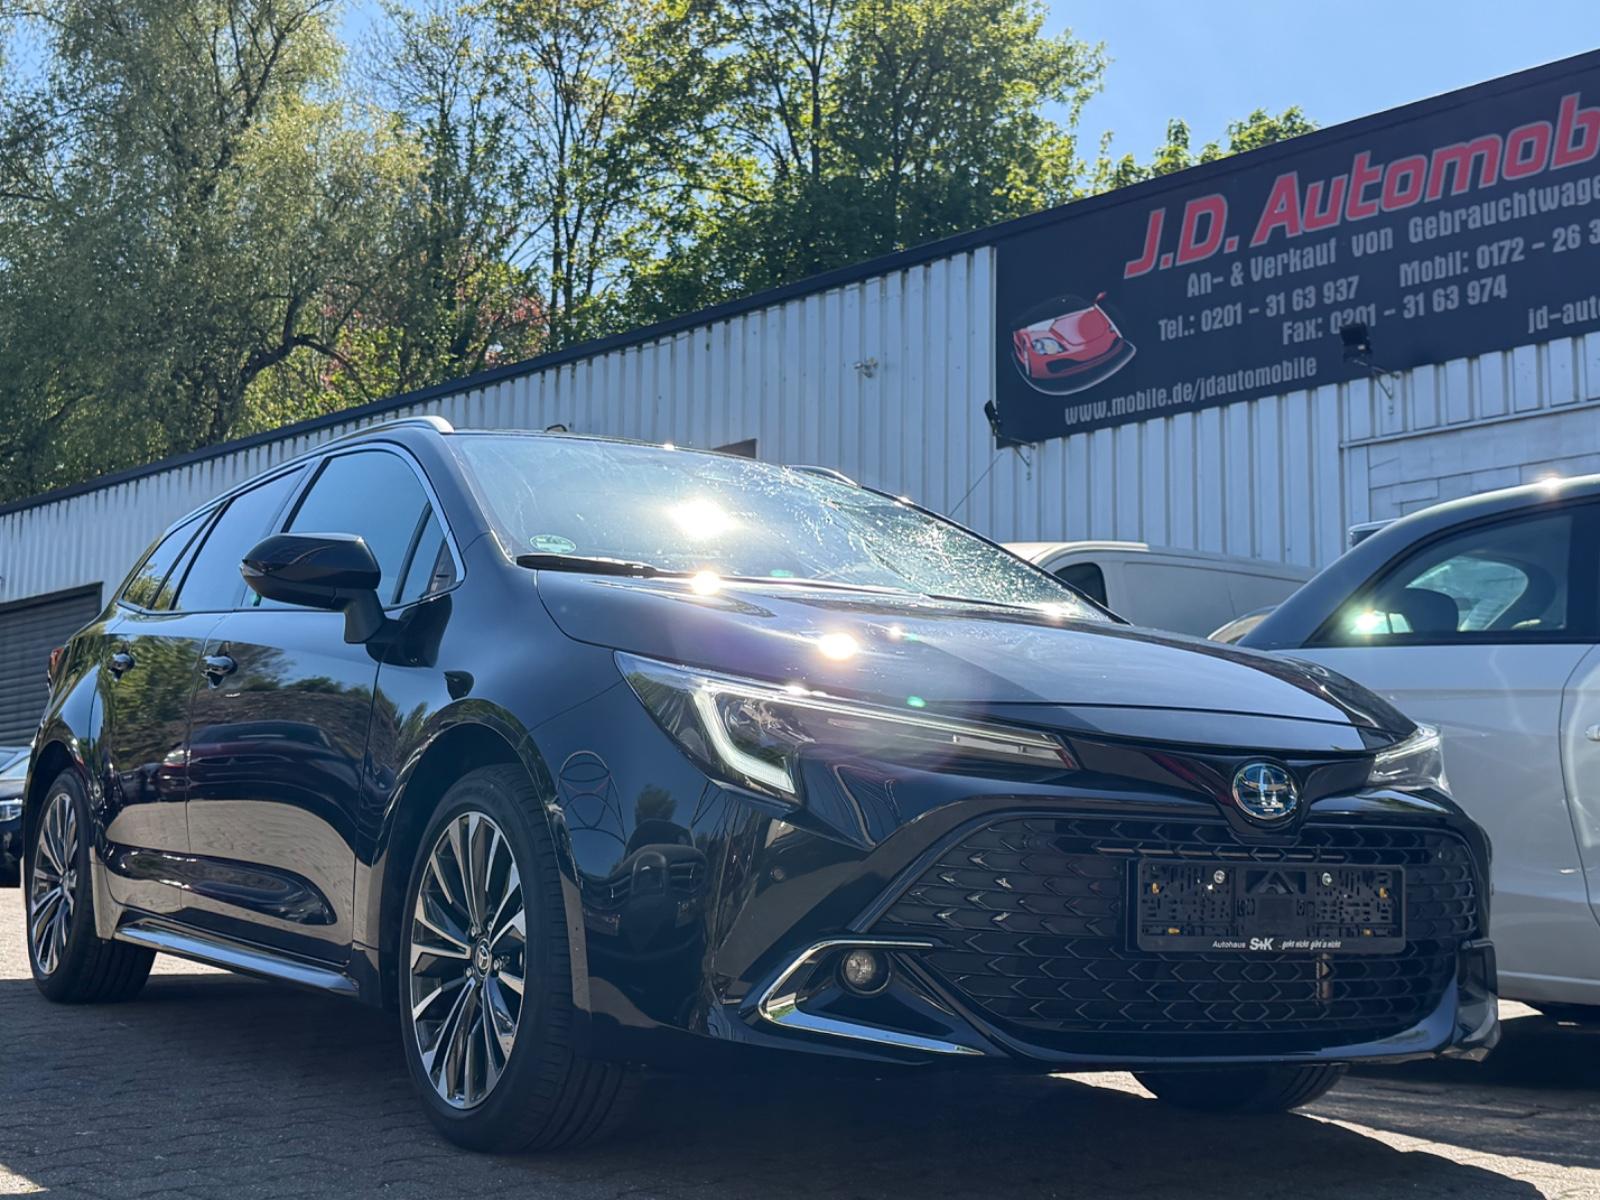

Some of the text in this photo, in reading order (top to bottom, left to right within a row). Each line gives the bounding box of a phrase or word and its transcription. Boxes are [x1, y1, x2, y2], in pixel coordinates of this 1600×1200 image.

[1123, 91, 1600, 279] J.D. Automob
[1187, 271, 1224, 298] An-
[1230, 261, 1244, 287] &
[1250, 237, 1337, 282] Verkauf
[1351, 227, 1393, 257] von
[1400, 250, 1469, 288] Mobil:
[1476, 236, 1525, 270] 0172
[1552, 223, 1581, 253] 26
[1589, 219, 1600, 244] 3
[1158, 315, 1195, 341] Tel.:
[1201, 302, 1242, 333] 0201
[1265, 292, 1285, 317] 31
[1292, 285, 1316, 312] 63
[1323, 275, 1359, 304] 937
[1282, 317, 1323, 345] Fax:
[1403, 292, 1424, 319] 31
[1432, 285, 1459, 313] 63
[1467, 274, 1508, 305] 974
[1528, 295, 1600, 334] jd-aut
[1064, 356, 1317, 425] www.mobile.de/jdautomobile
[1212, 940, 1246, 948] Autohaus
